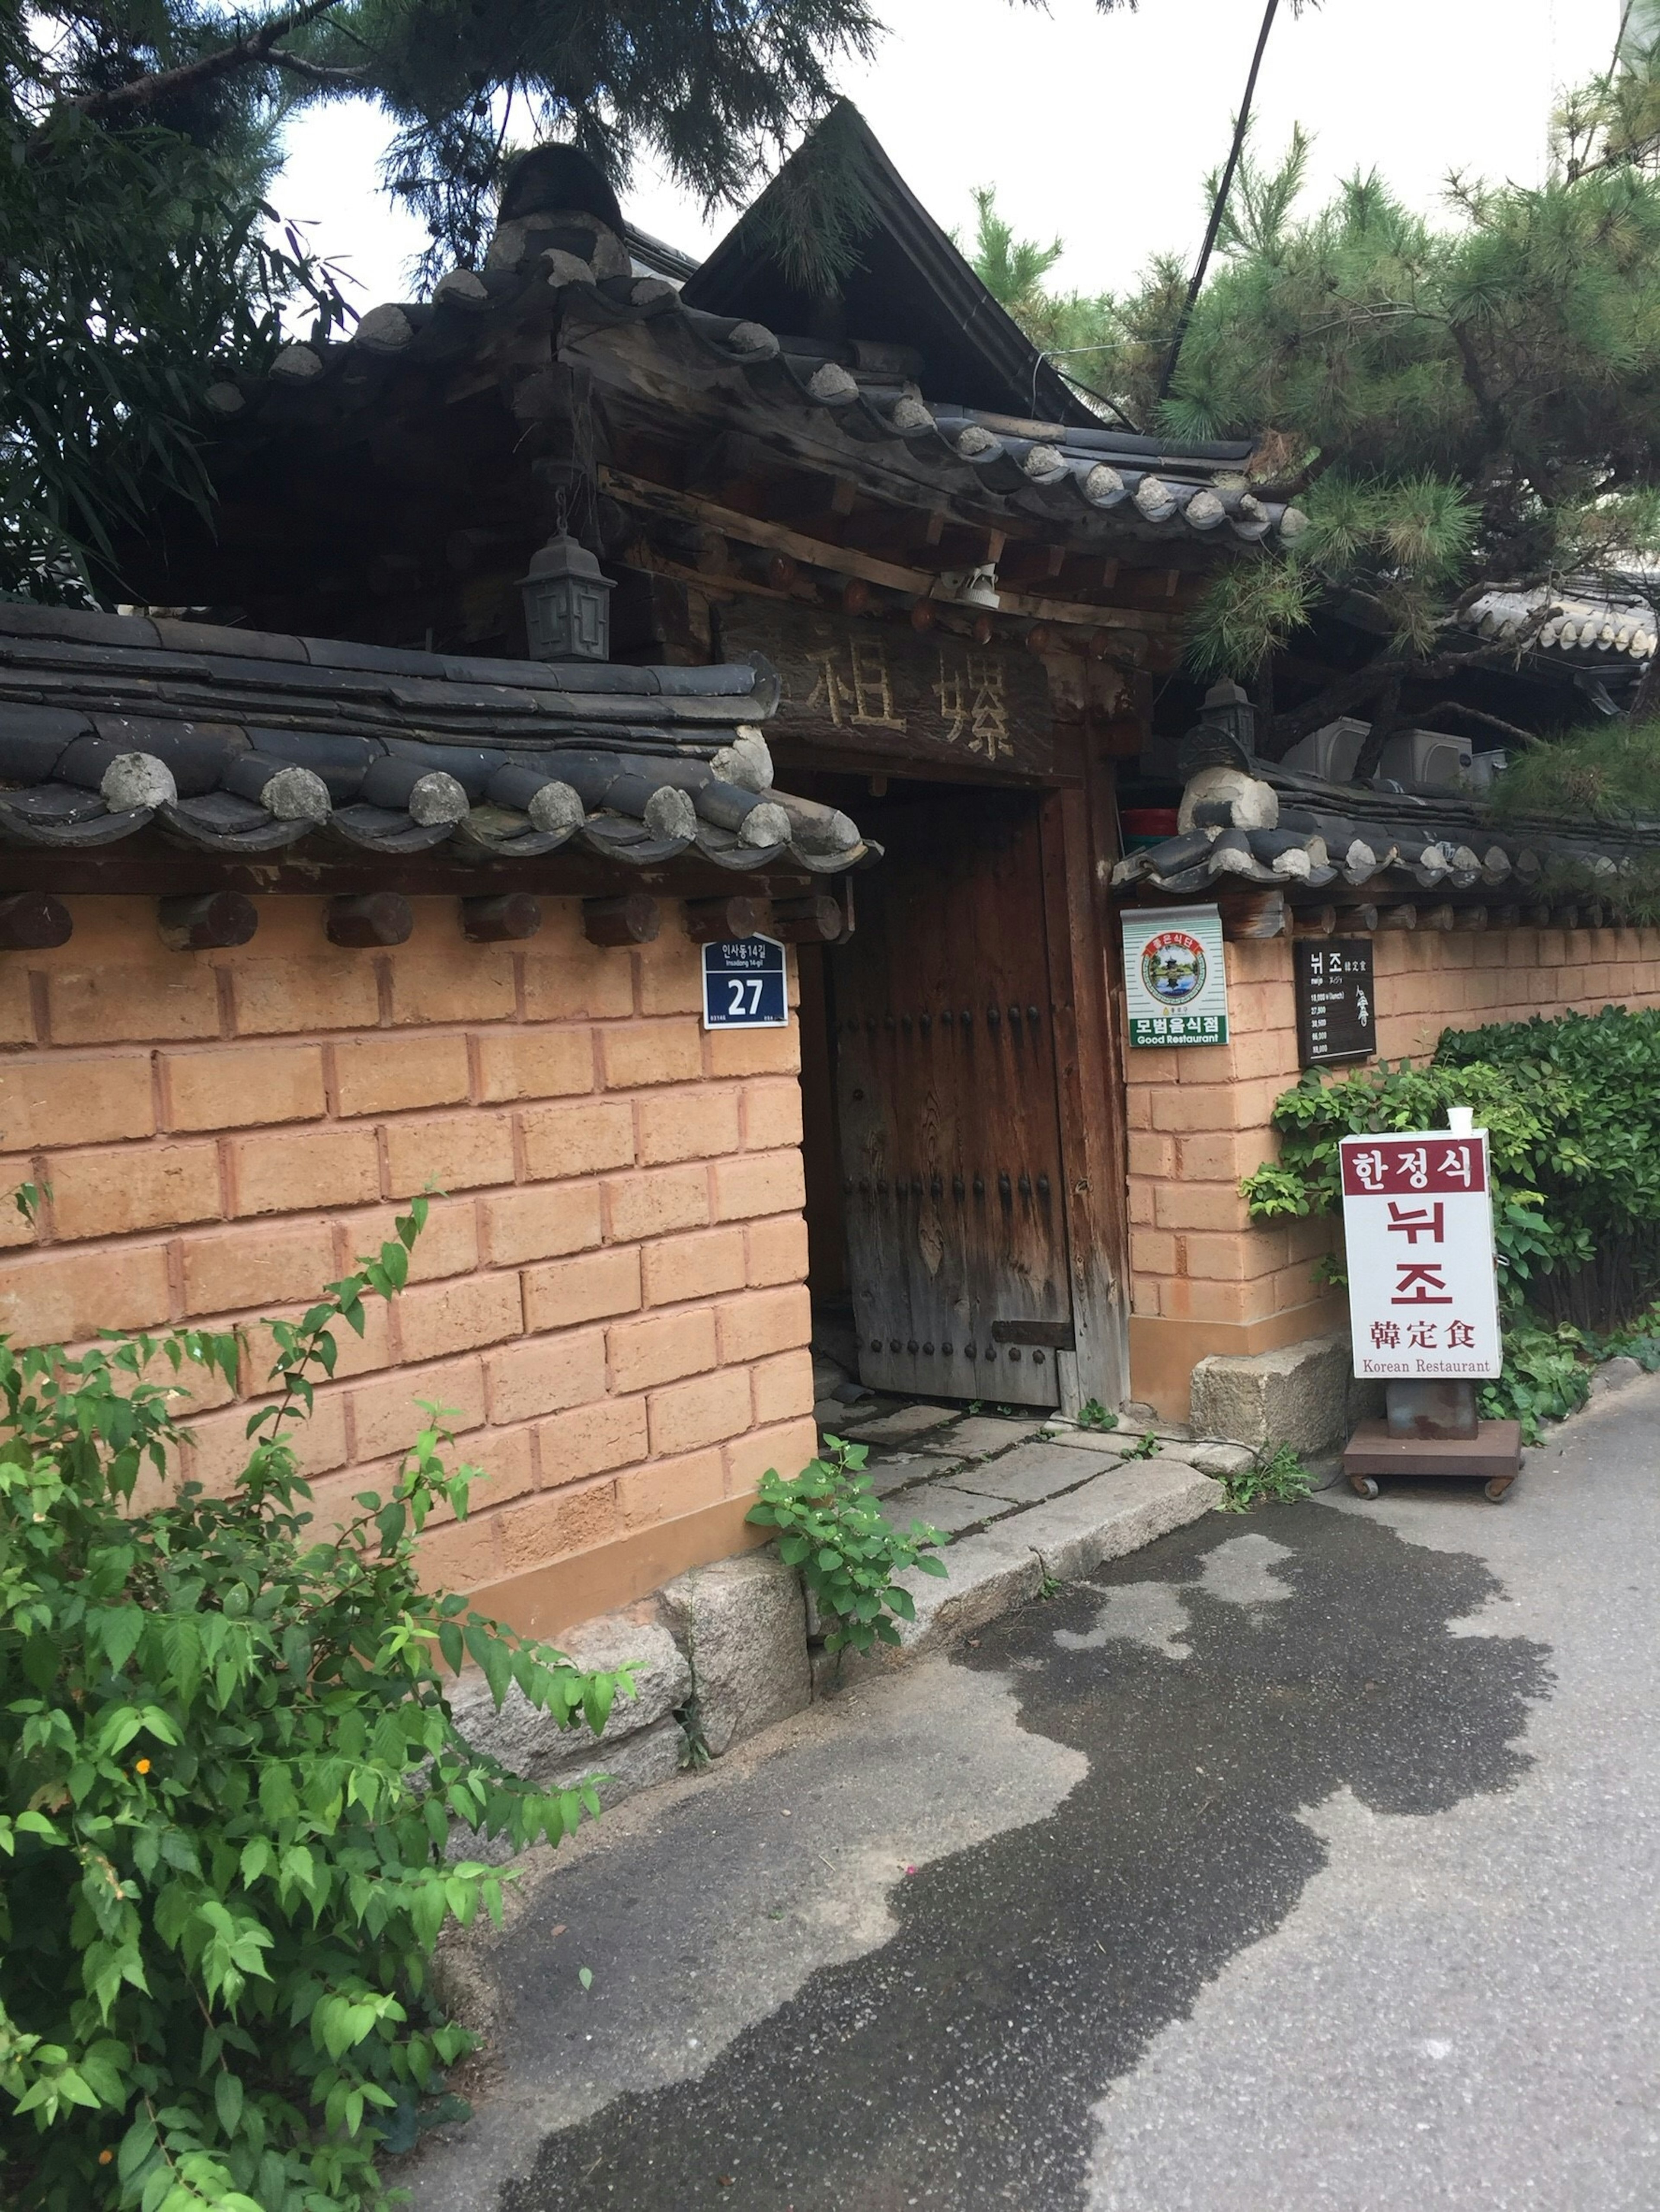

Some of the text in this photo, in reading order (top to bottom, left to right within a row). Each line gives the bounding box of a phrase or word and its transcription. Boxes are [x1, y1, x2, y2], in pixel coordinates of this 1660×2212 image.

[722, 944, 766, 959] 인사동14길
[726, 959, 749, 968] Insadong
[728, 979, 763, 1015] 27
[1136, 1017, 1219, 1034] 모범음식점
[1137, 1033, 1219, 1044] Good Restaurant
[1352, 1146, 1475, 1190] 한정식
[1370, 1320, 1476, 1349] 韓定食
[1363, 1359, 1491, 1373] Korean Restaurant
